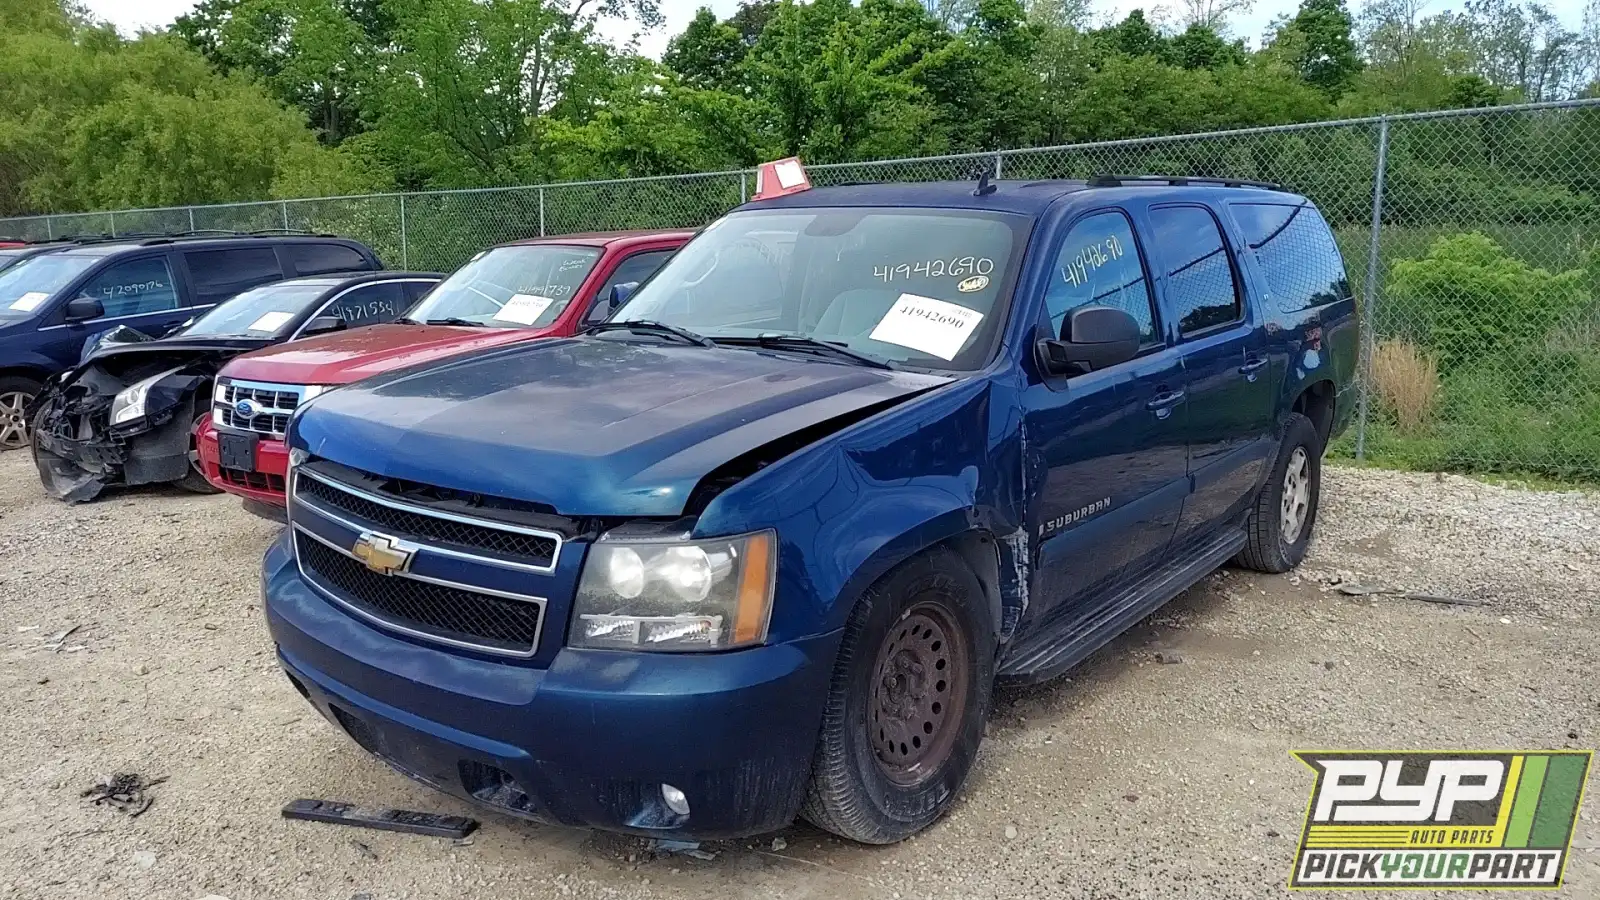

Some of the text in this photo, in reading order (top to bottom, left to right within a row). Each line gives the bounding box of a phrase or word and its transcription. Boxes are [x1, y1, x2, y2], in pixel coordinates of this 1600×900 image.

[873, 257, 994, 282] 41942690
[1061, 235, 1123, 288] 41942690
[103, 280, 164, 299] 42090176
[899, 306, 965, 329] 41942690
[1046, 496, 1111, 532] SUBURBAN
